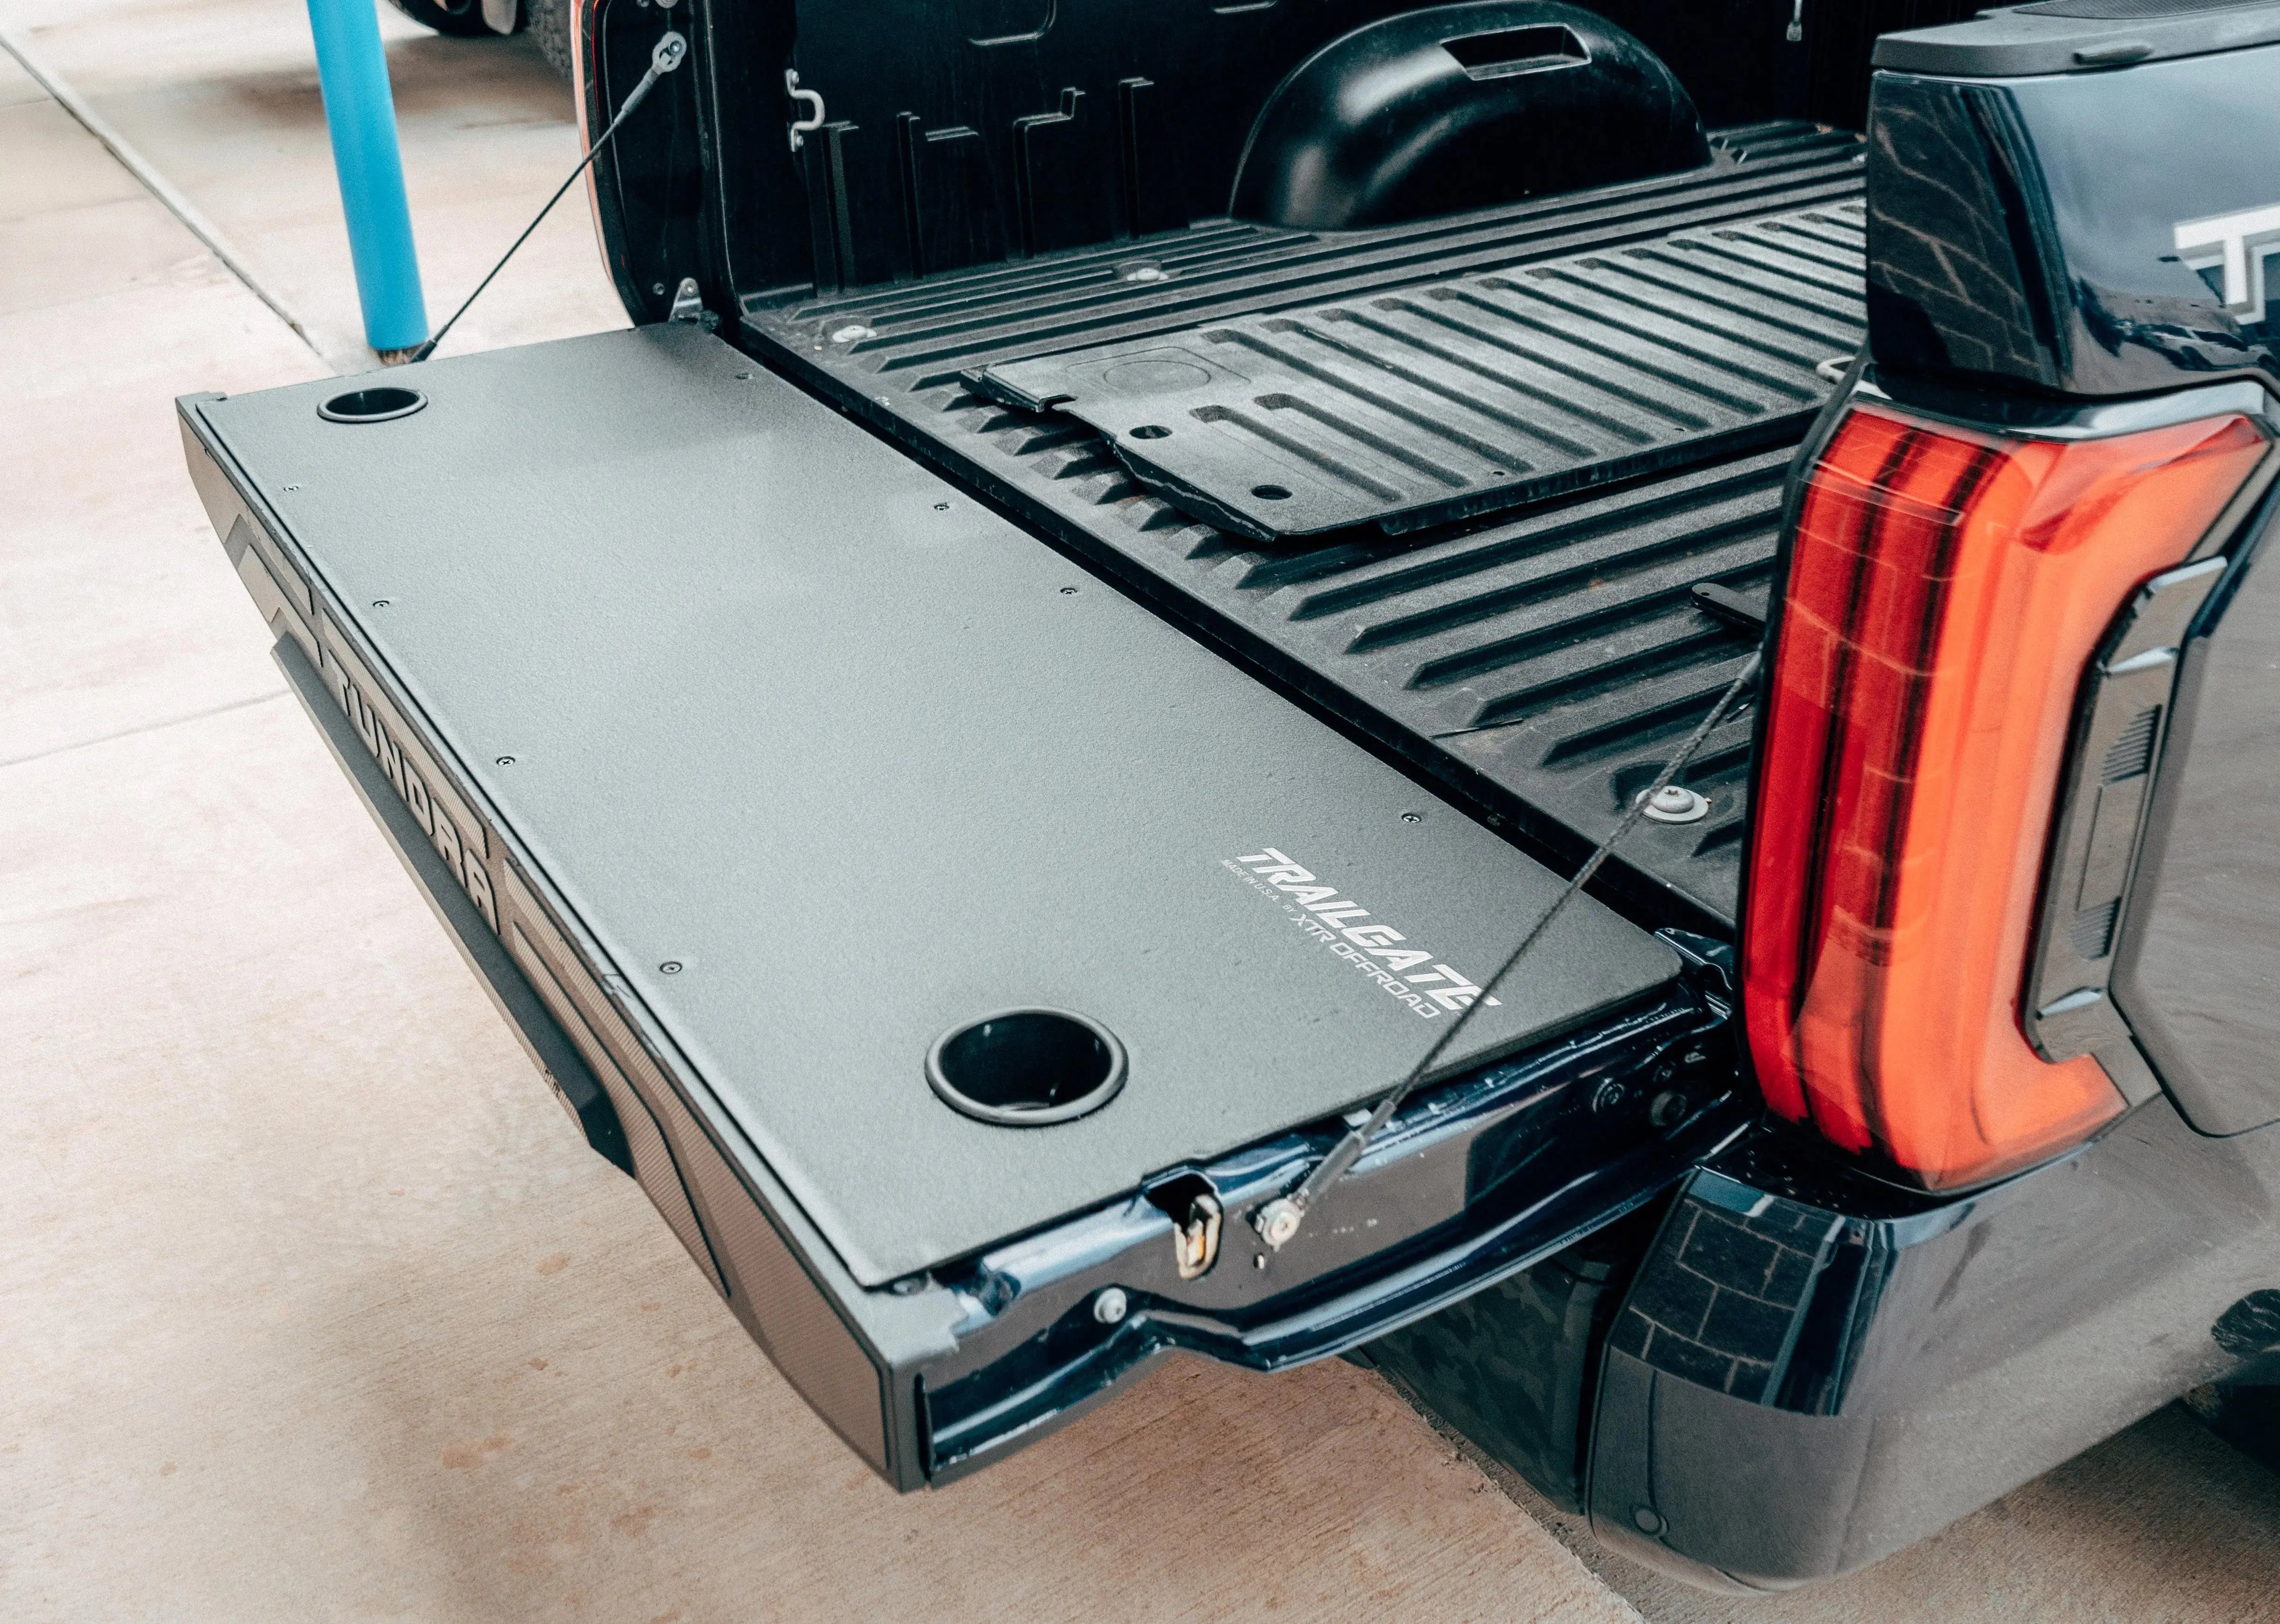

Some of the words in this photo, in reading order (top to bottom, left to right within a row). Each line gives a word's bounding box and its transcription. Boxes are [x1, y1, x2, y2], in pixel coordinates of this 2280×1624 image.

[328, 648, 500, 935] TUNDRA
[1221, 859, 1249, 877] MADE
[1290, 913, 1337, 943] XTR
[1330, 942, 1441, 1018] OFFROAD
[1236, 848, 1503, 1010] TRAILGATE
